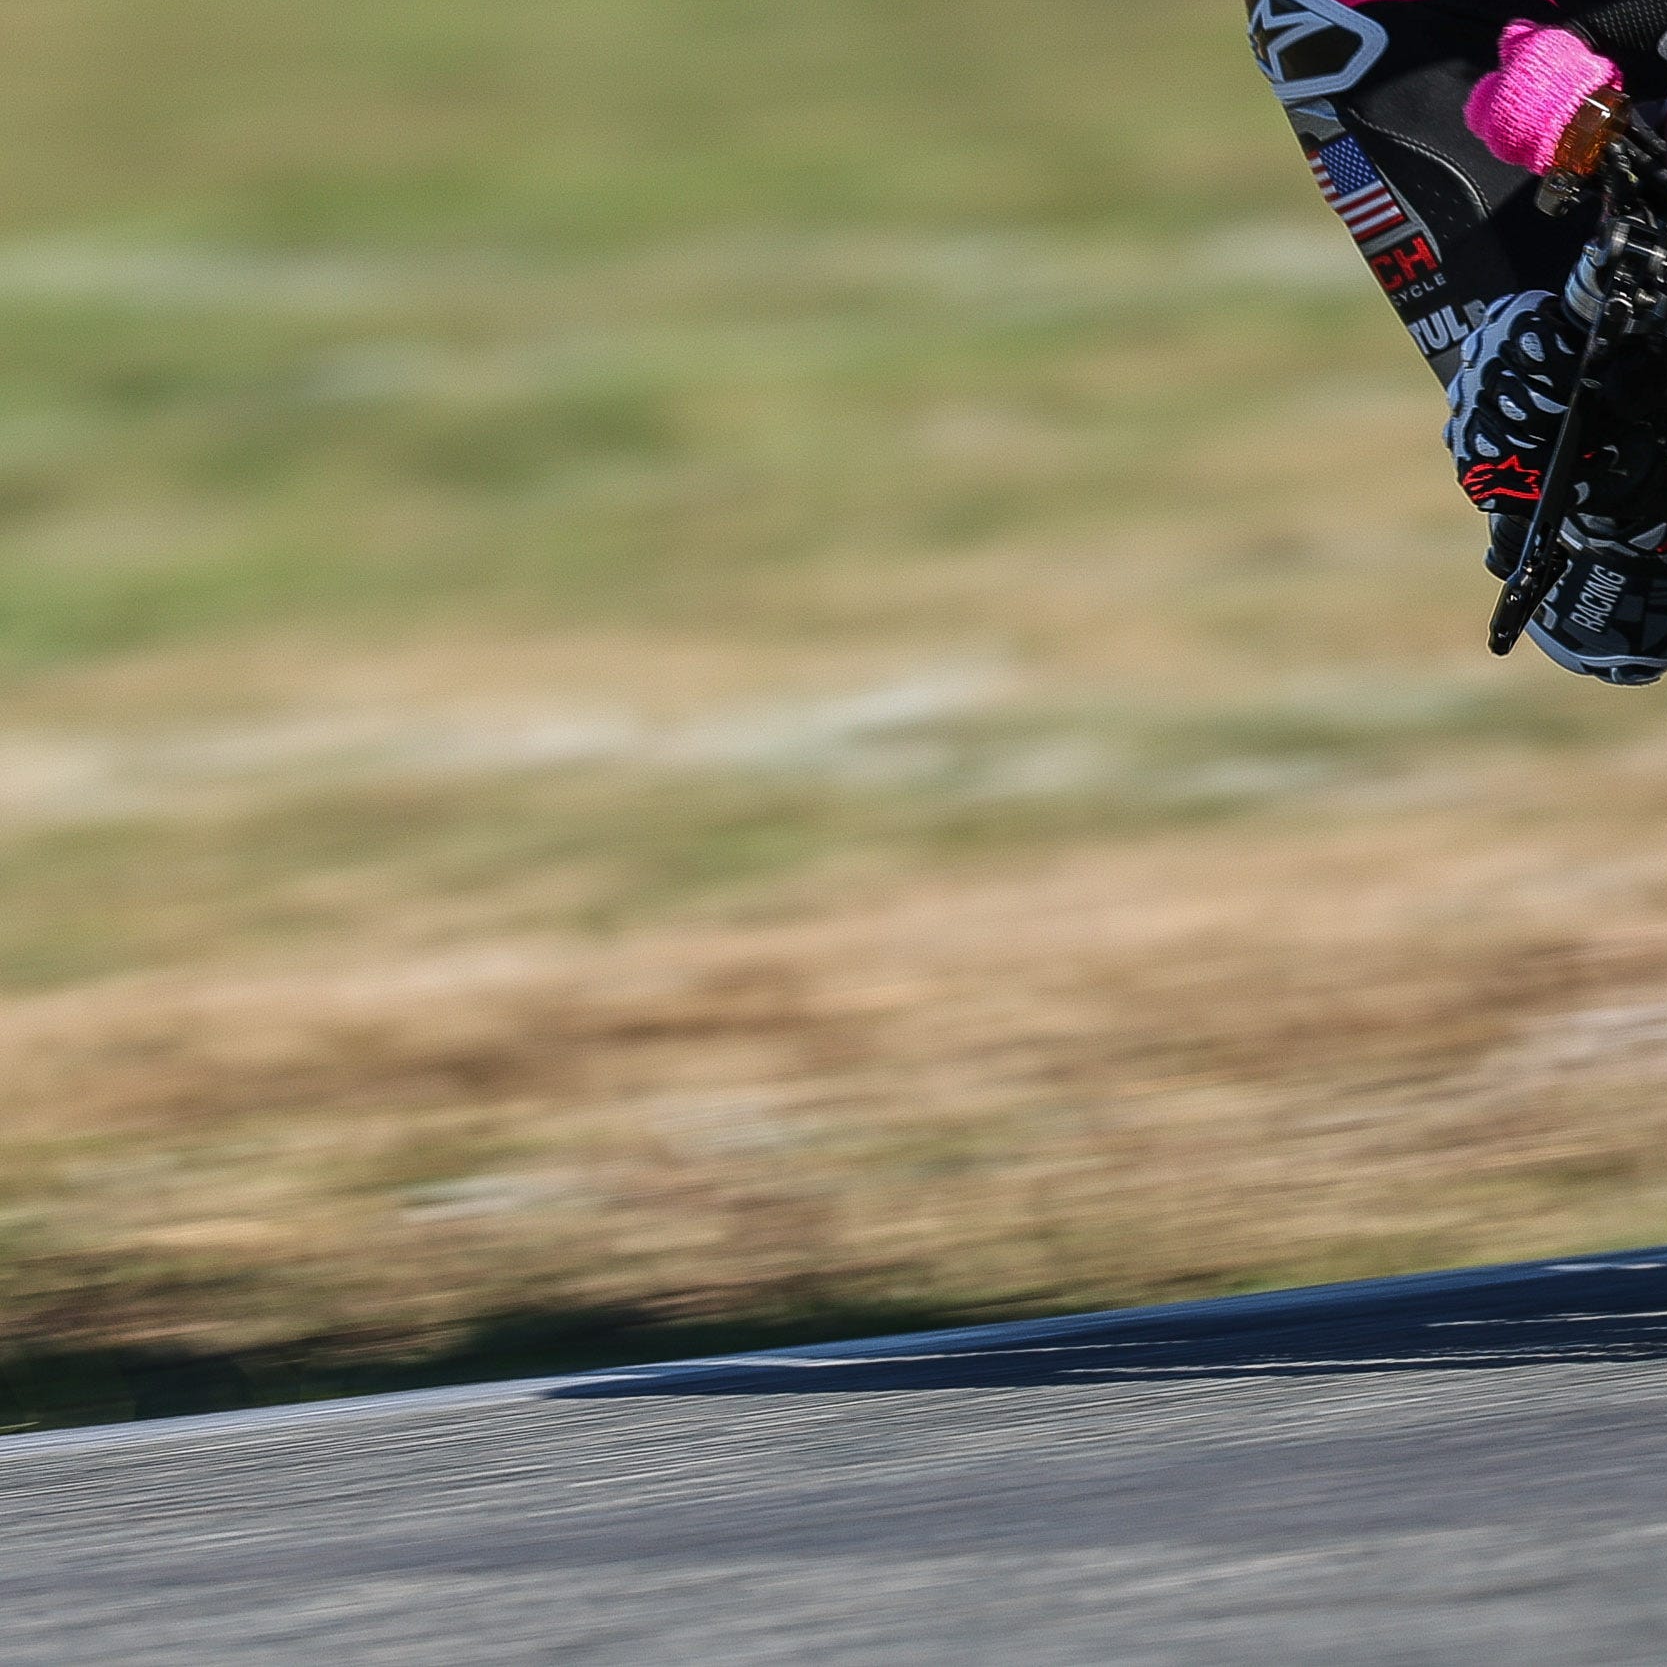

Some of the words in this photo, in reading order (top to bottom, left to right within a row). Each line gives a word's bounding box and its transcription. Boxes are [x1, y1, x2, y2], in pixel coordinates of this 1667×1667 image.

[1369, 235, 1438, 292] CH
[1407, 304, 1469, 355] TUL
[1569, 563, 1627, 634] RACING
